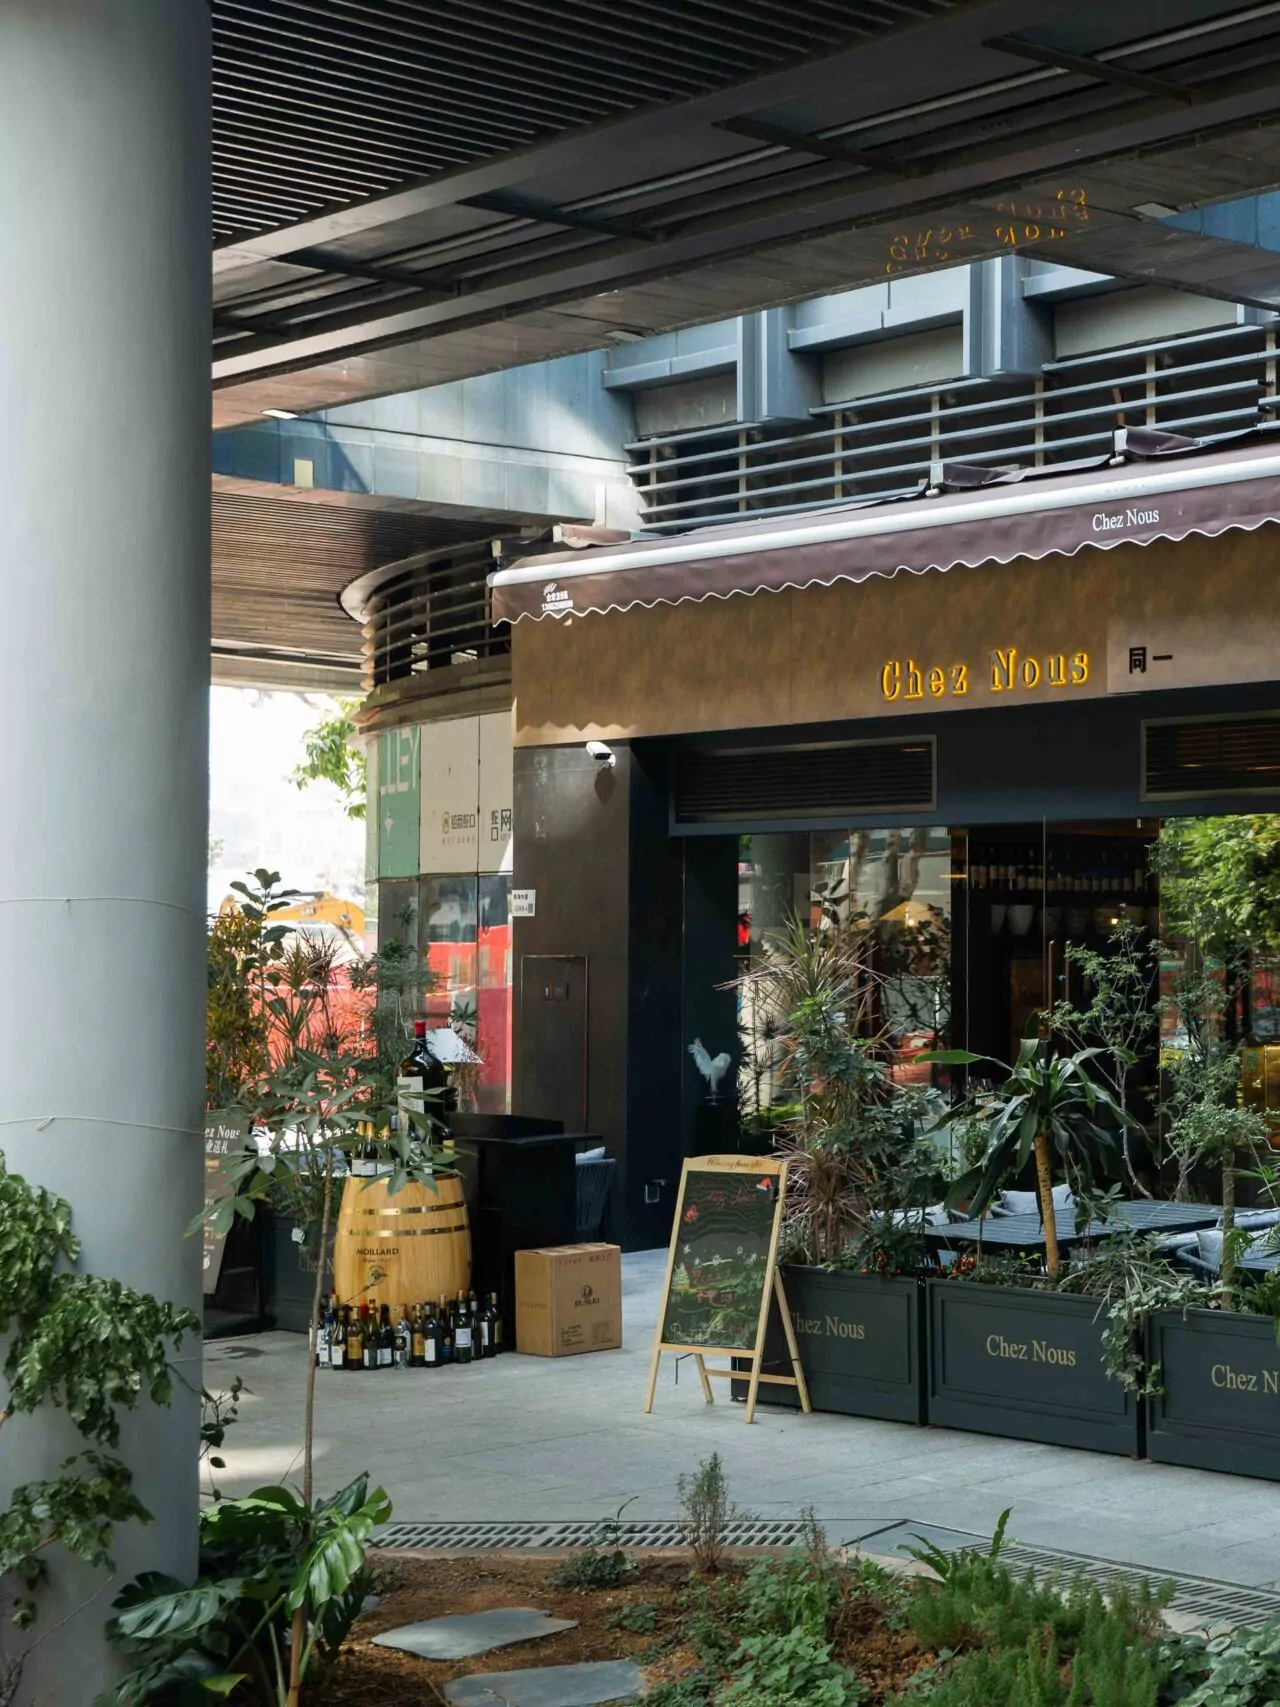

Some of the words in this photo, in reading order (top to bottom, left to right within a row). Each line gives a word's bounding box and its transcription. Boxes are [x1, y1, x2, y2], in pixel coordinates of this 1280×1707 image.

[1092, 513, 1124, 531] Chez
[1125, 508, 1160, 527] Nous
[1128, 646, 1173, 674] 同一
[880, 658, 969, 701] Chez
[990, 648, 1090, 692] Nous
[356, 1247, 400, 1256] MOILLARD
[824, 1314, 865, 1341] Nous
[986, 1334, 1028, 1360] Chez
[1031, 1340, 1077, 1367] Nous
[1211, 1364, 1258, 1392] Chez
